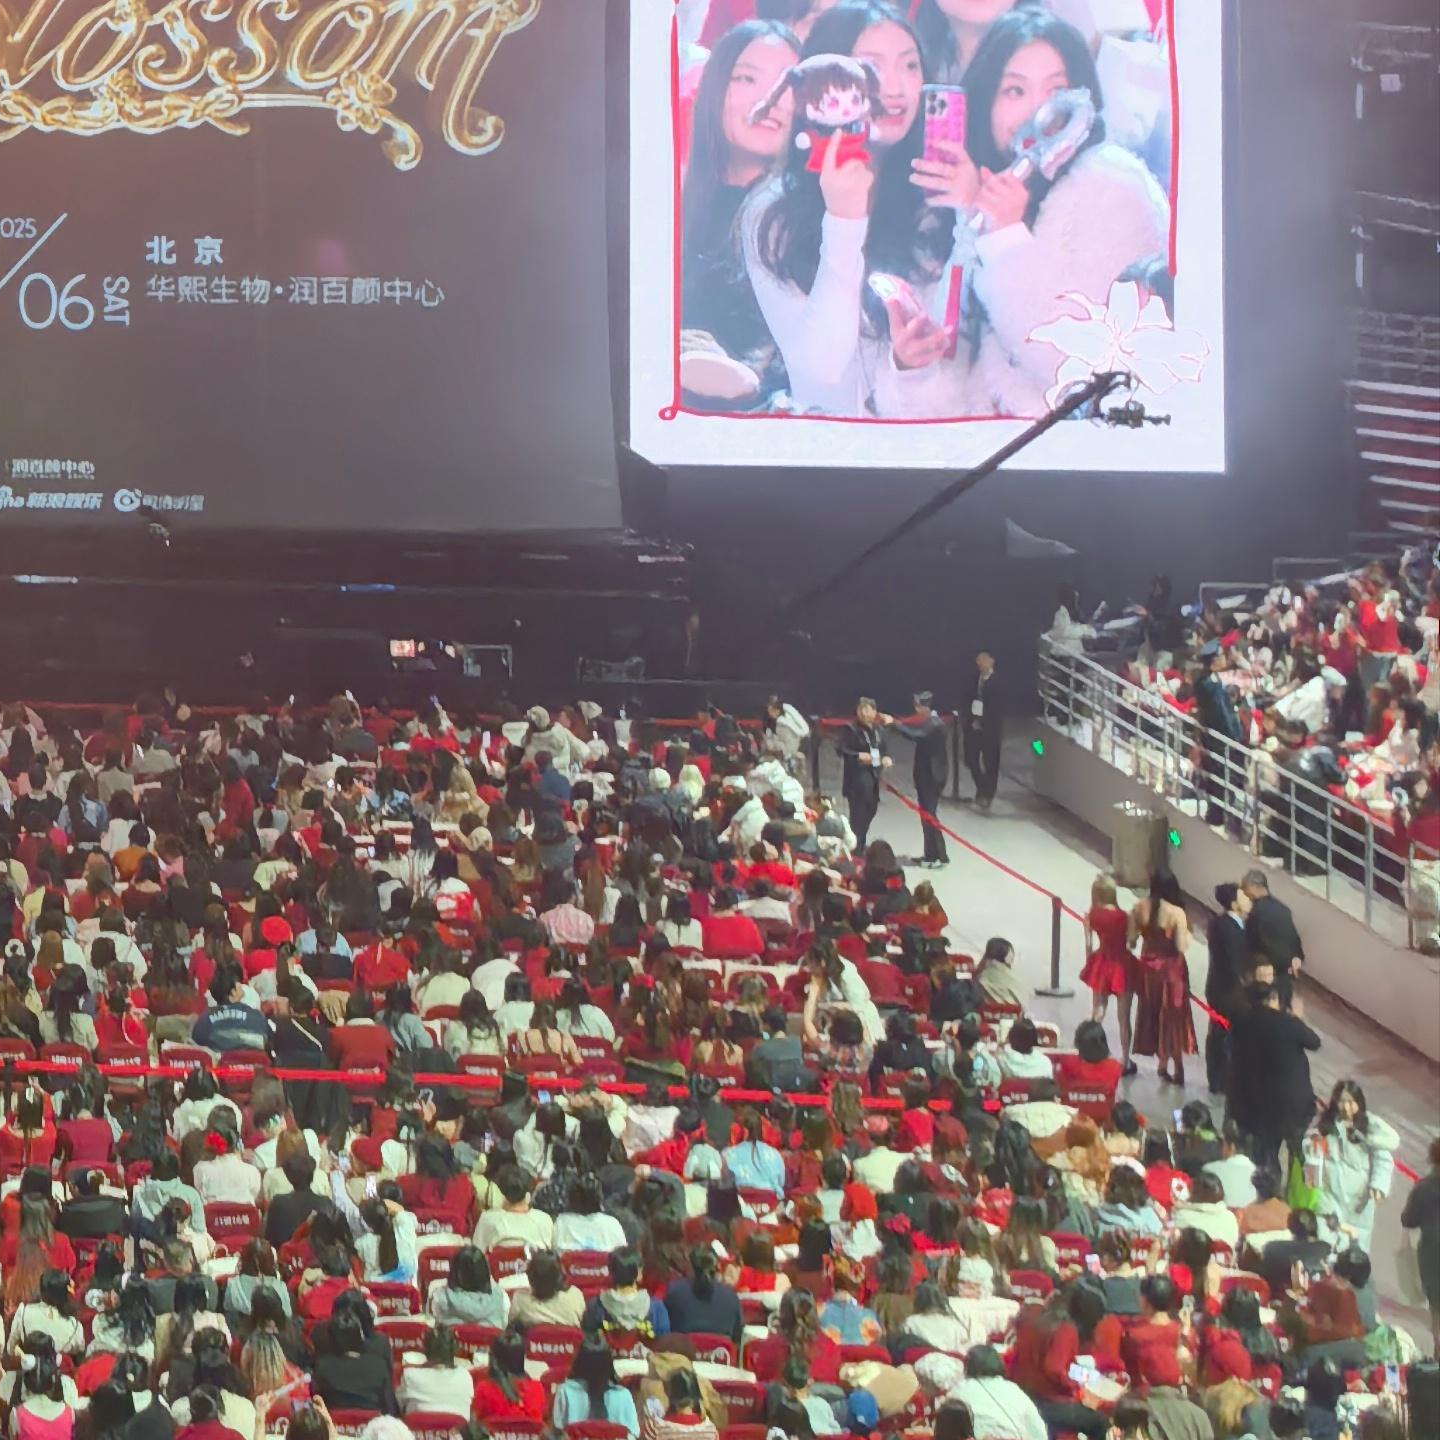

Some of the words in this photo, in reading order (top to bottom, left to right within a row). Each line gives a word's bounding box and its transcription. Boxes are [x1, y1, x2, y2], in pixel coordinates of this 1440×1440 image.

[145, 235, 224, 266] 北京
[19, 272, 96, 331] 06
[102, 275, 131, 326] SAT
